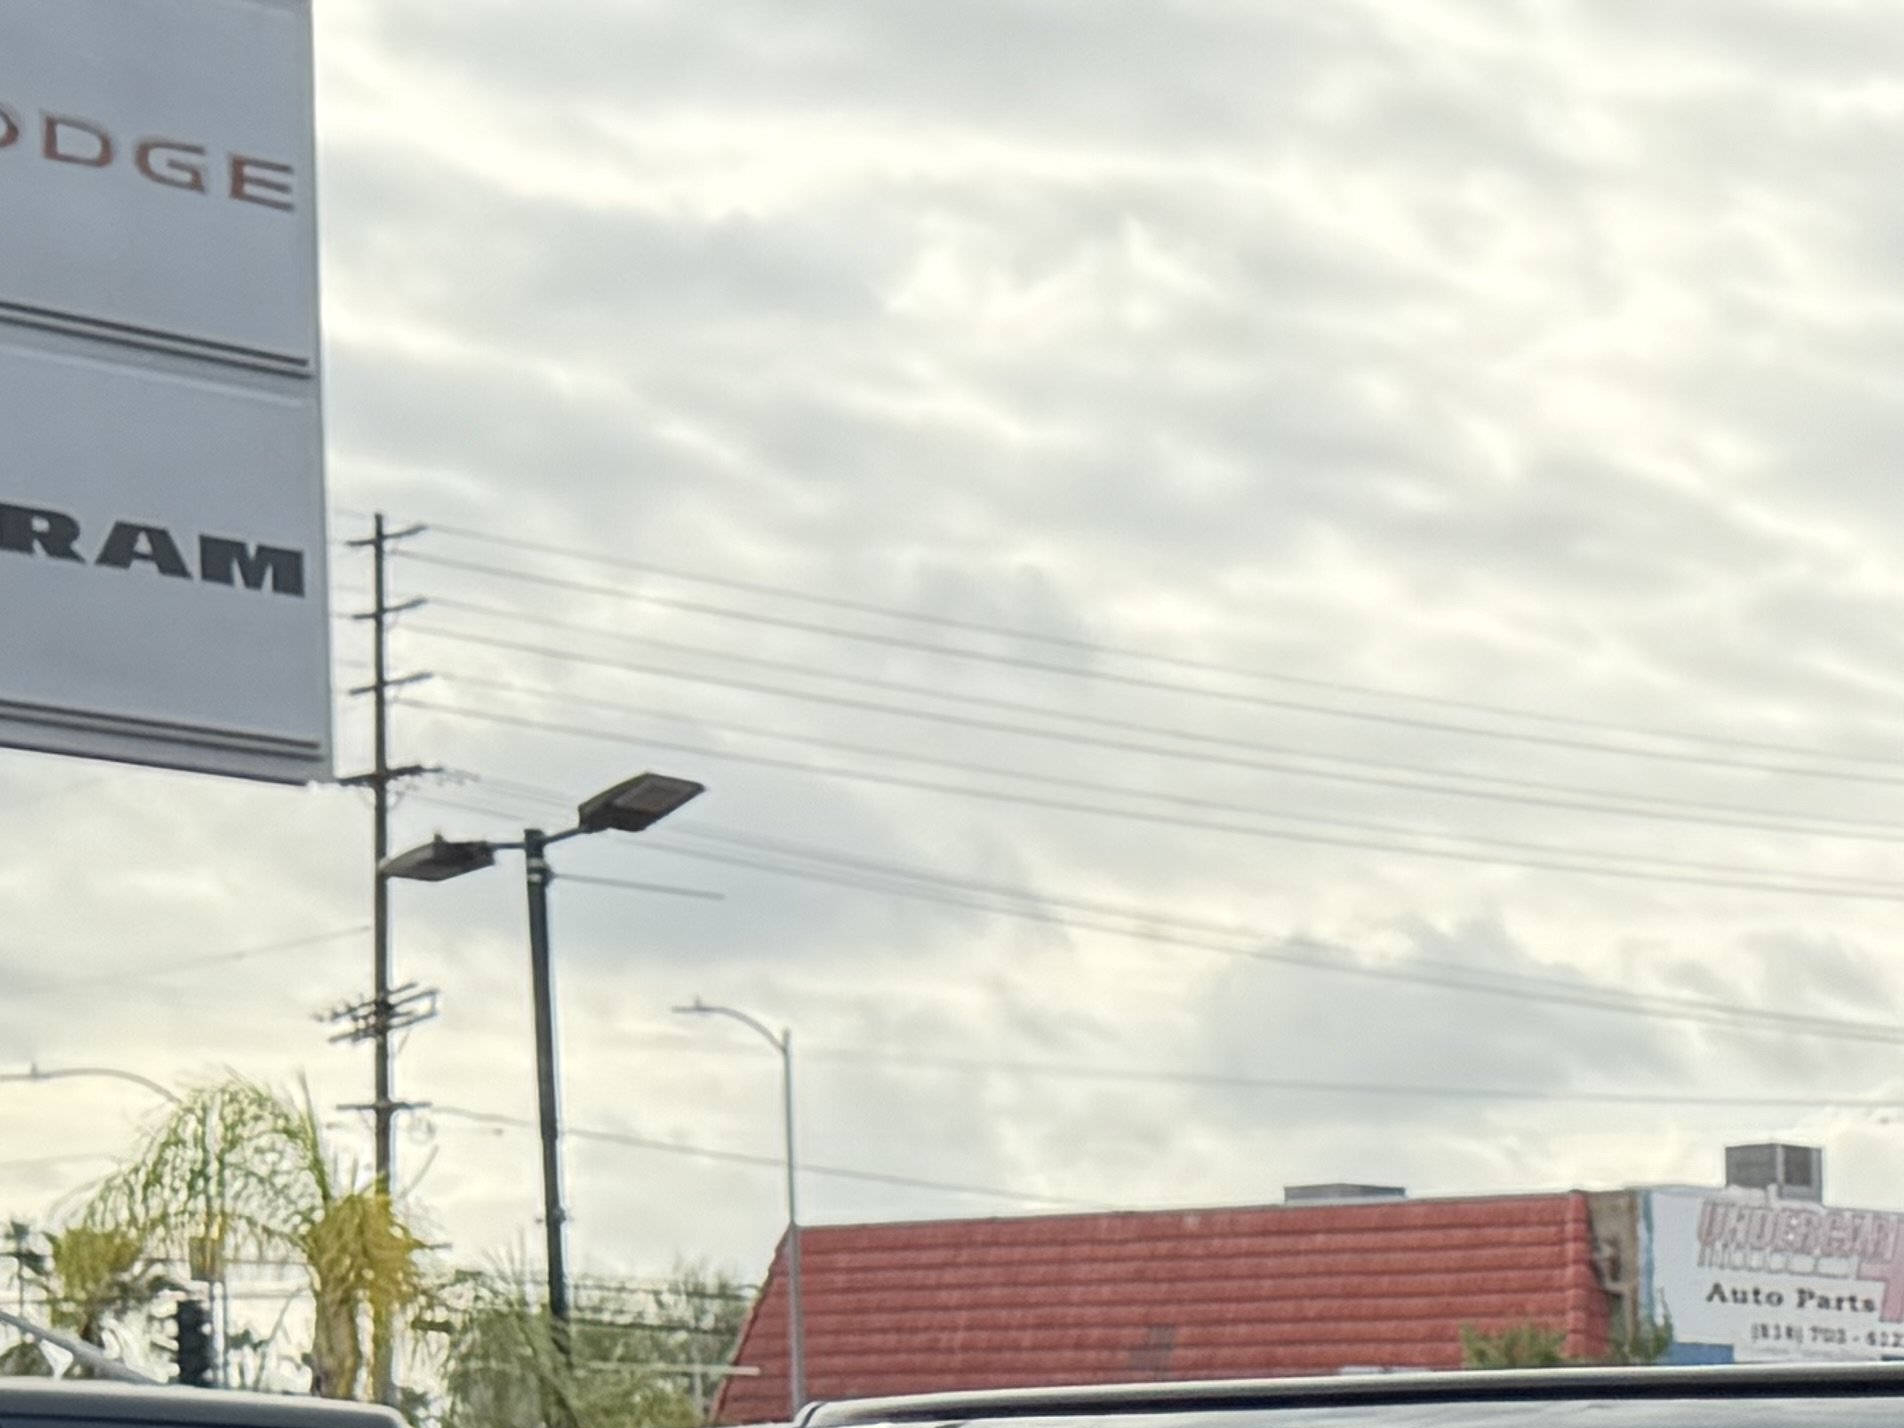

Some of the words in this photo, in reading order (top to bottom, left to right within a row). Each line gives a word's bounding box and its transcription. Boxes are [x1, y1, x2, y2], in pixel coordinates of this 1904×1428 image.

[0, 107, 294, 211] DGE
[0, 503, 305, 597] RAM
[1706, 1282, 1784, 1307] Auto
[1797, 1287, 1876, 1313] Parts
